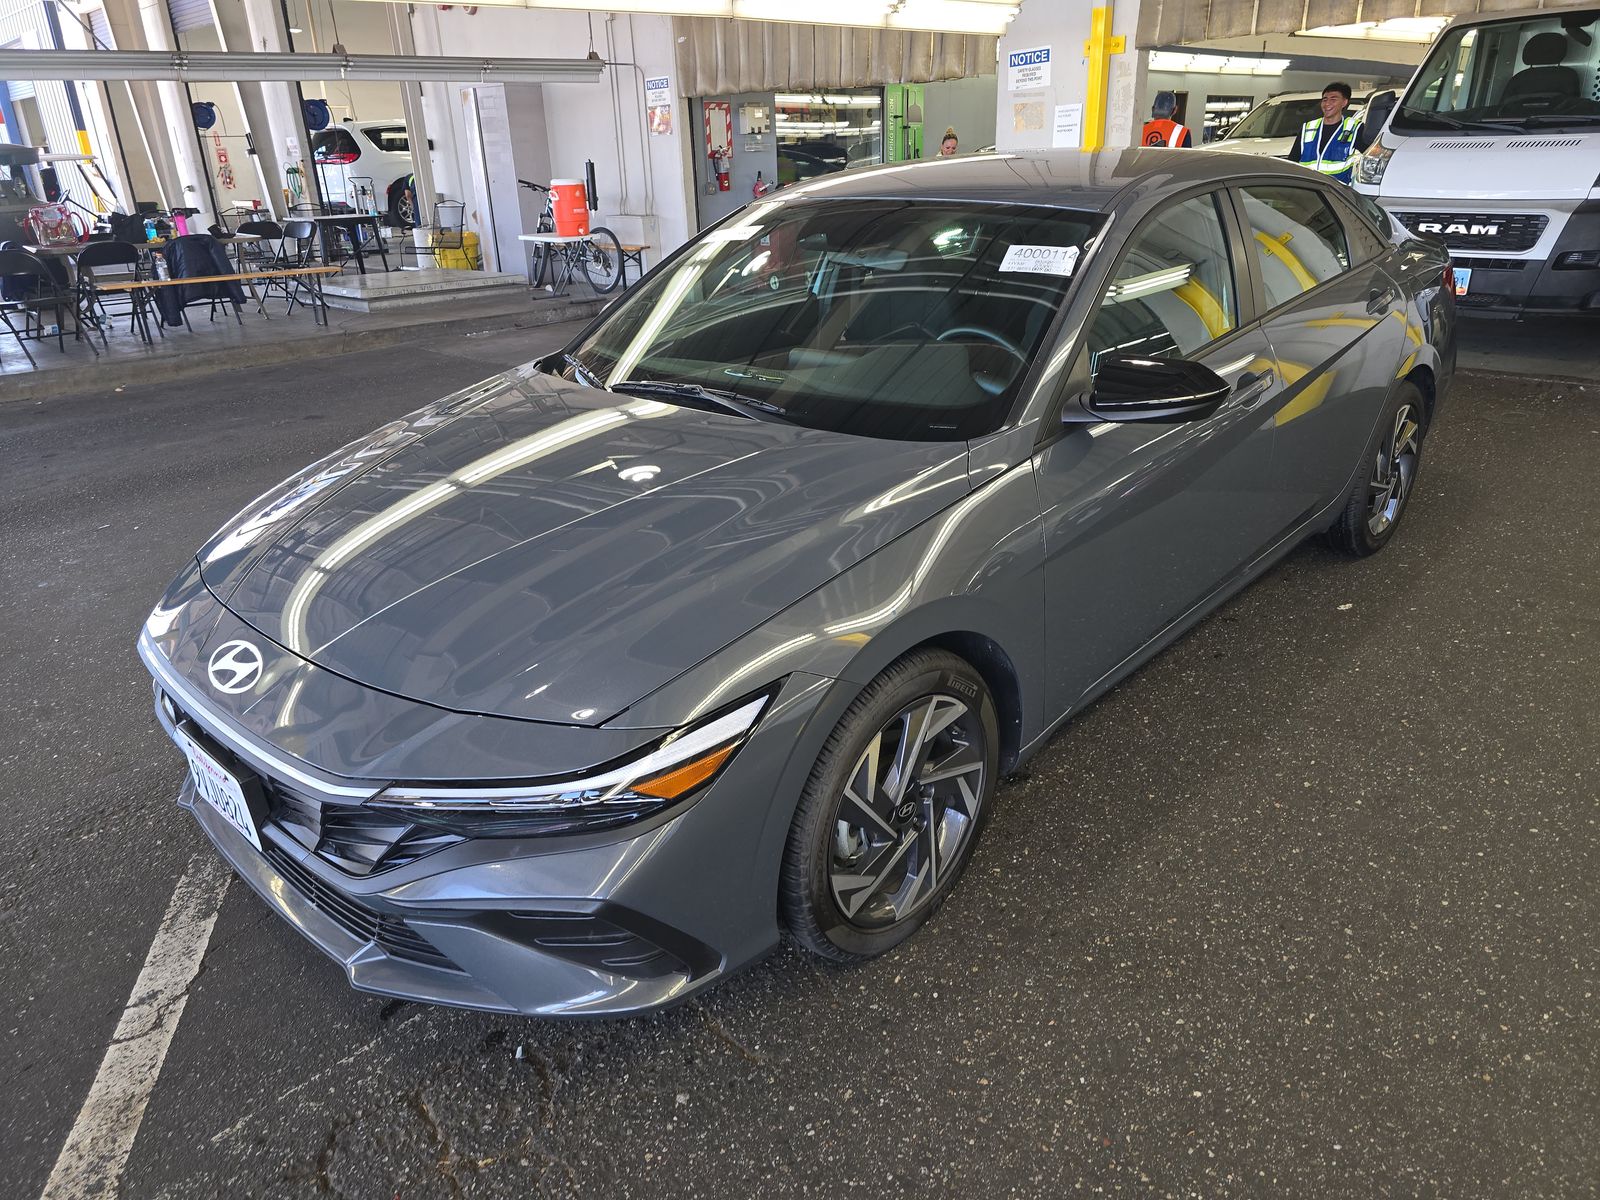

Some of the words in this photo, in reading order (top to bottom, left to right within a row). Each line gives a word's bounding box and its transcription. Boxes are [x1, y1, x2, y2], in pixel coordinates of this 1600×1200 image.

[1011, 50, 1048, 66] NOTICE
[647, 79, 668, 90] NOTICE
[1418, 223, 1499, 235] RAM
[1014, 248, 1078, 261] 4000114
[947, 673, 979, 698] PIRELLI
